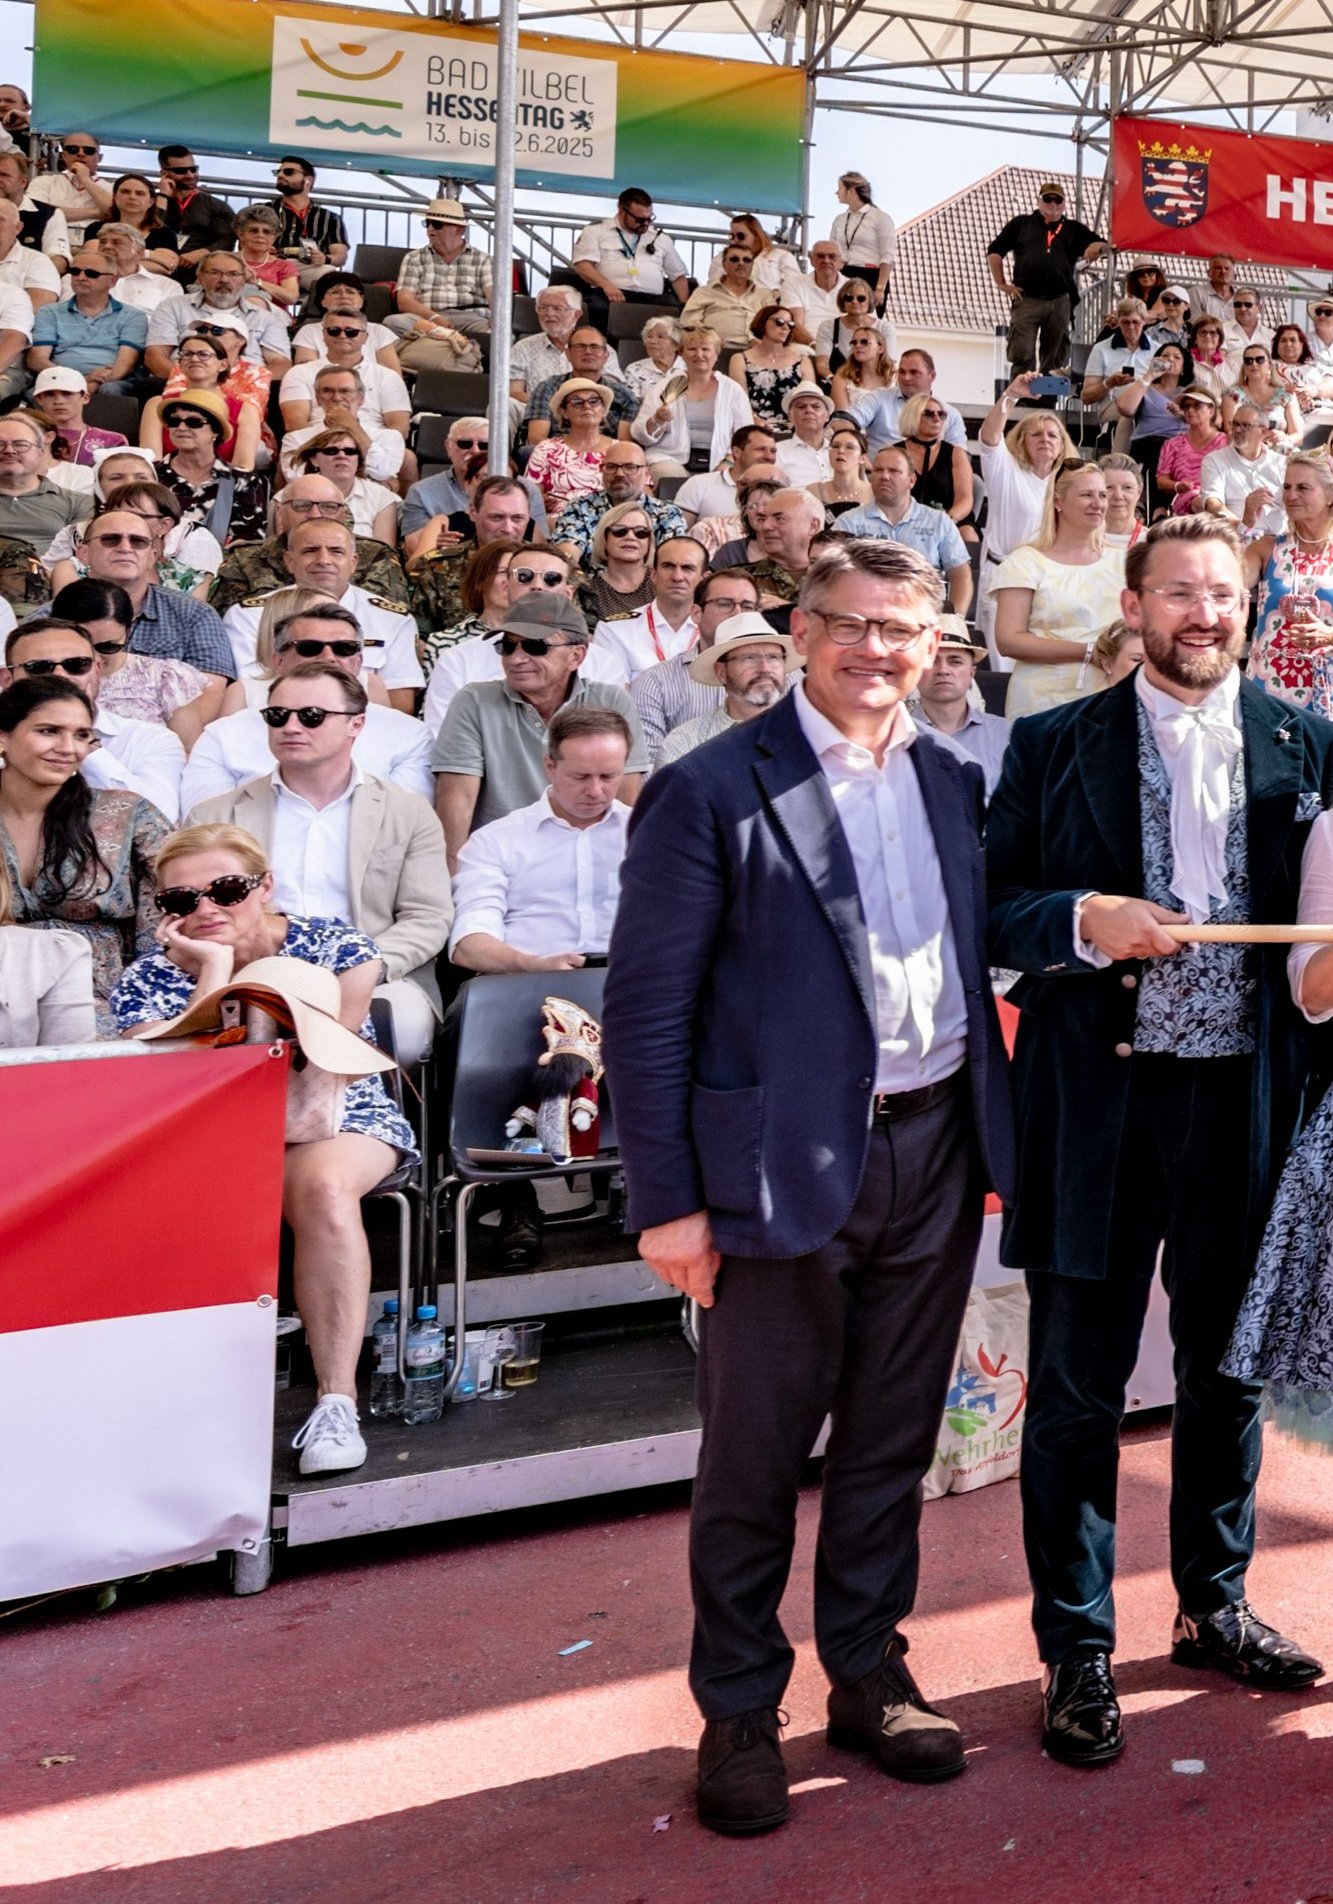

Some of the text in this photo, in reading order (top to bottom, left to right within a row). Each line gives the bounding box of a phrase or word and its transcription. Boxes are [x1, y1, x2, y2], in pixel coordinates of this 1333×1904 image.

[427, 55, 595, 106] BAD ILBEL
[426, 91, 565, 130] HESSETAG
[425, 121, 594, 158] 13. bis 2.6.2025
[934, 1429, 1020, 1467] ehrhe
